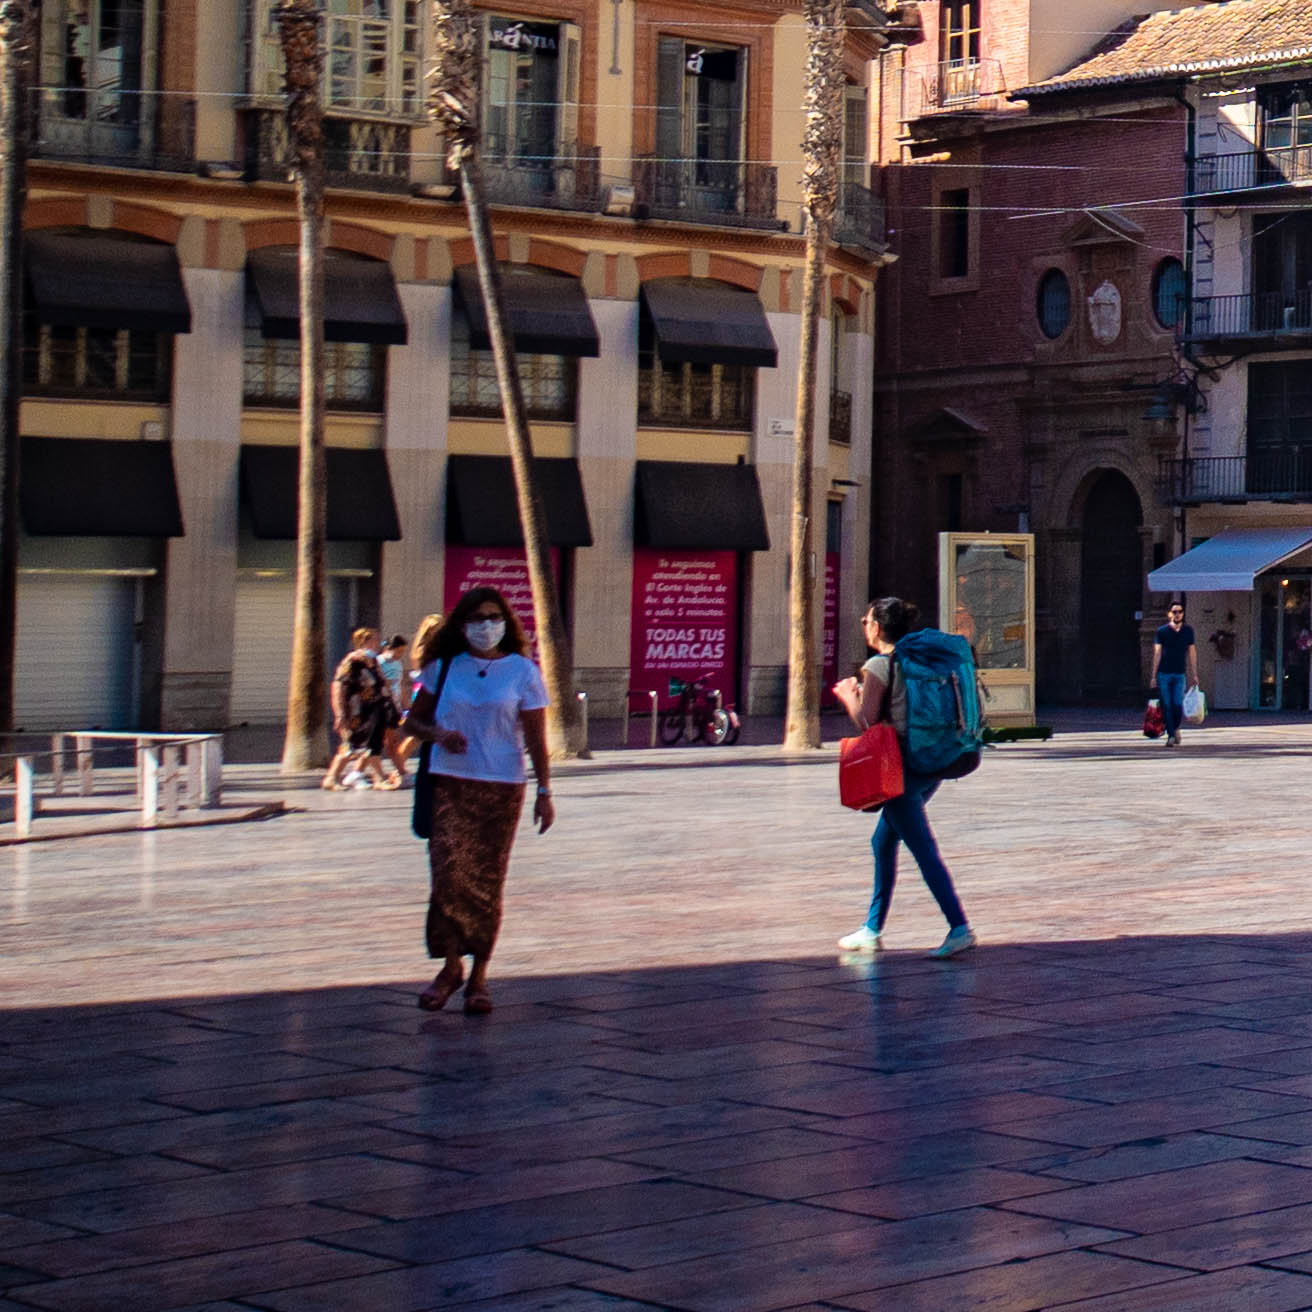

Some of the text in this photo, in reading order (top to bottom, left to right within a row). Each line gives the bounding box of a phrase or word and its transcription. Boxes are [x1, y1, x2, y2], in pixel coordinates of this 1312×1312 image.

[652, 570, 707, 580] atendiendo
[646, 628, 725, 641] TODAS TUS
[645, 643, 725, 659] MARCAS
